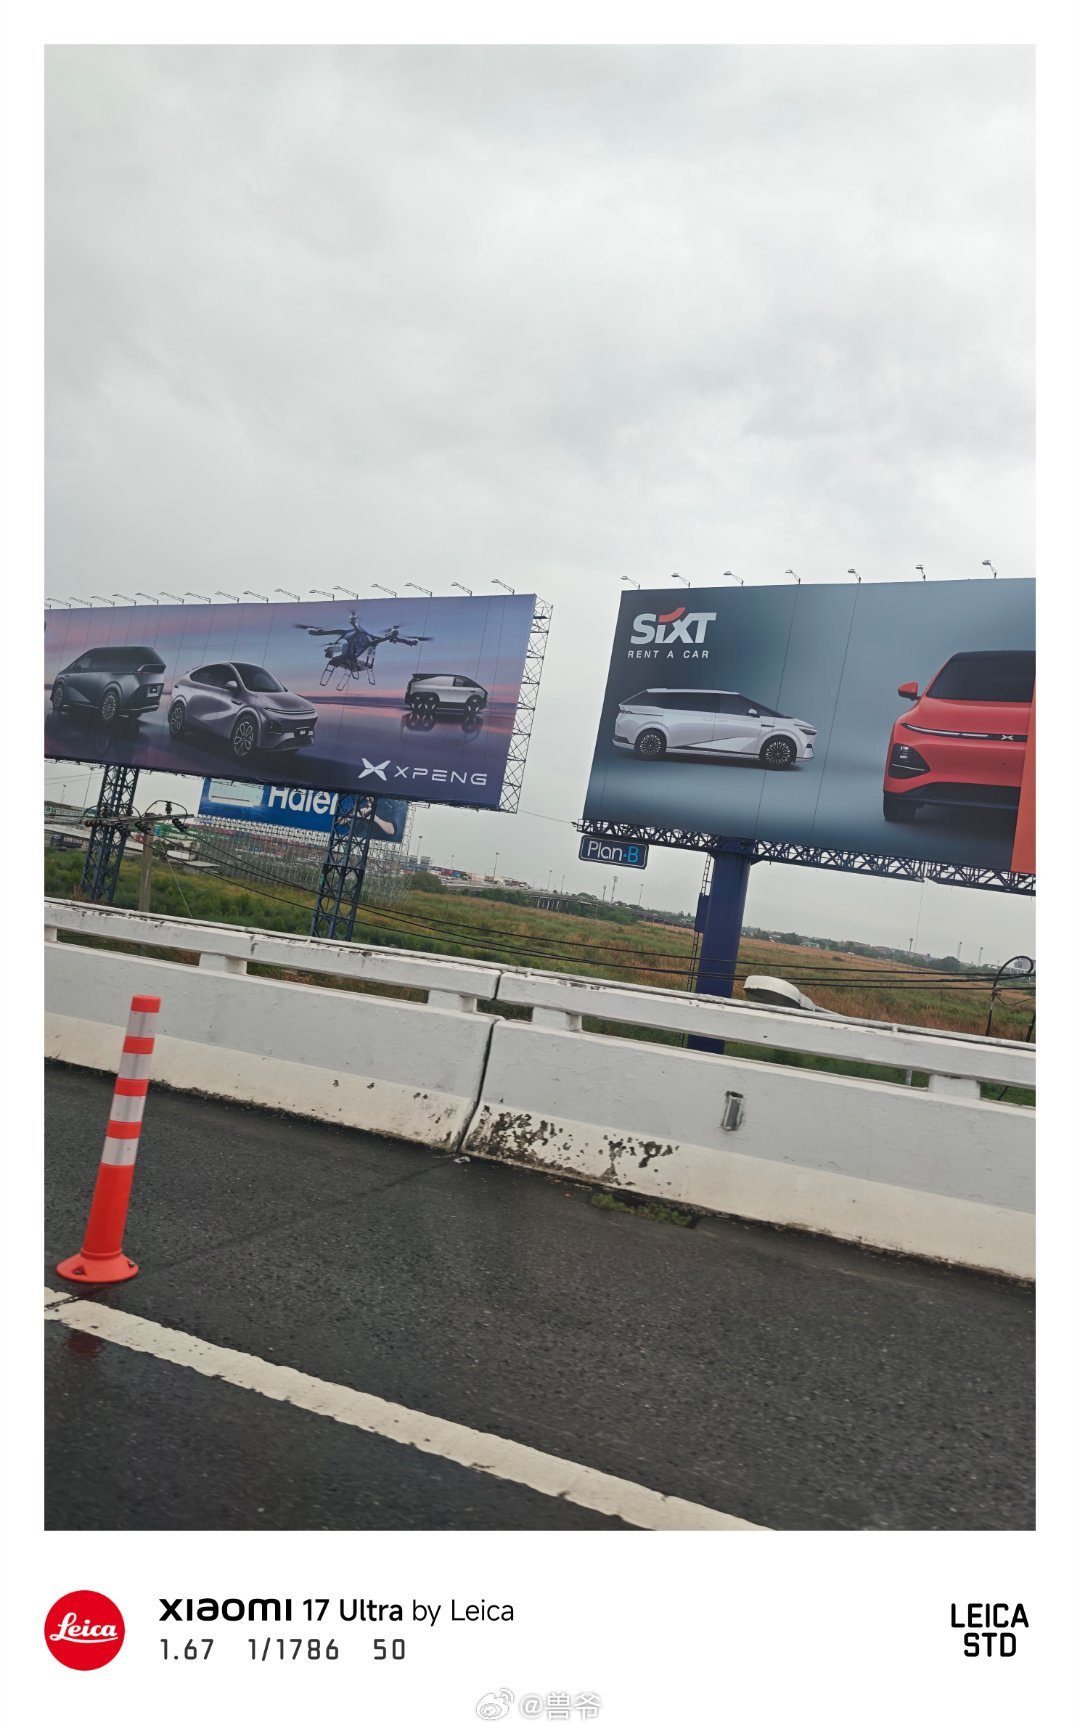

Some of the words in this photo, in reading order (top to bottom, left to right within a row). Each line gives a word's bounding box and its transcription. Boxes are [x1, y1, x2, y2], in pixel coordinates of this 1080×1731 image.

[627, 650, 660, 659] RENT
[666, 650, 674, 659] A
[683, 650, 710, 659] CAR
[394, 765, 488, 786] XPENG
